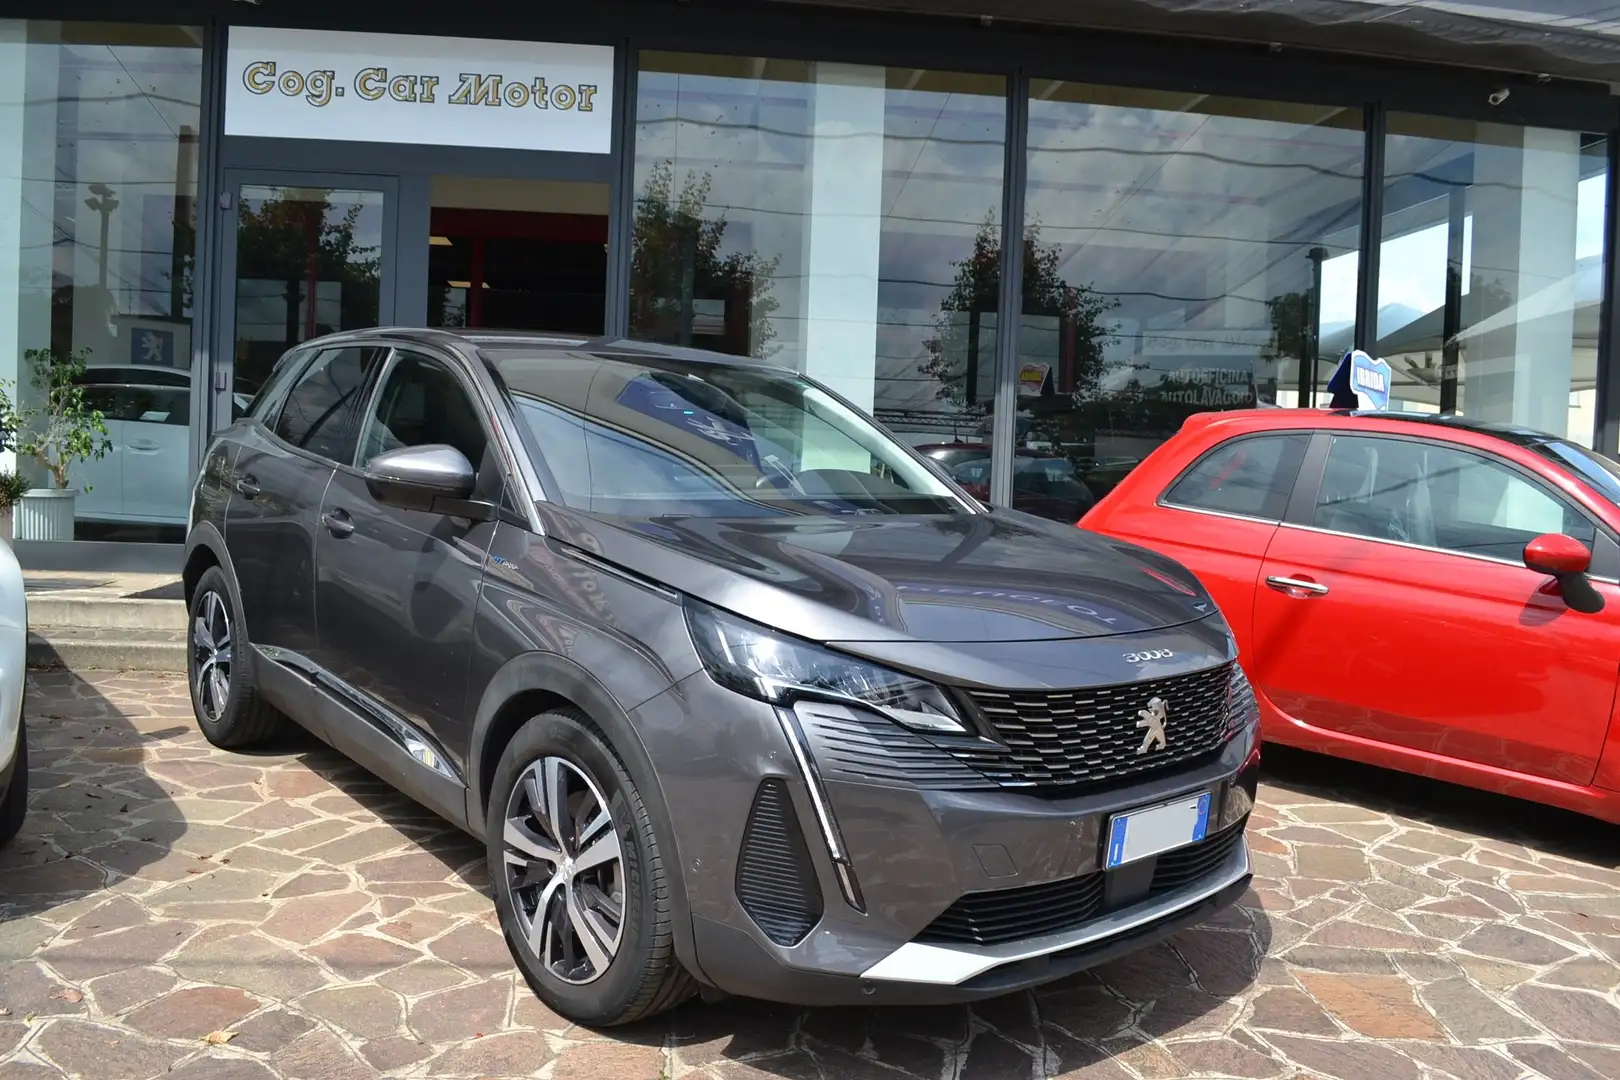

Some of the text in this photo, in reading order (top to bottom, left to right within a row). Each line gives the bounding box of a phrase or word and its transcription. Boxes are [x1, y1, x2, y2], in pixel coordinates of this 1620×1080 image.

[242, 61, 597, 112] Cog. Car Motor
[1357, 367, 1384, 392] IBRIDA
[1123, 648, 1173, 662] 3008
[626, 842, 643, 938] MICHELI
